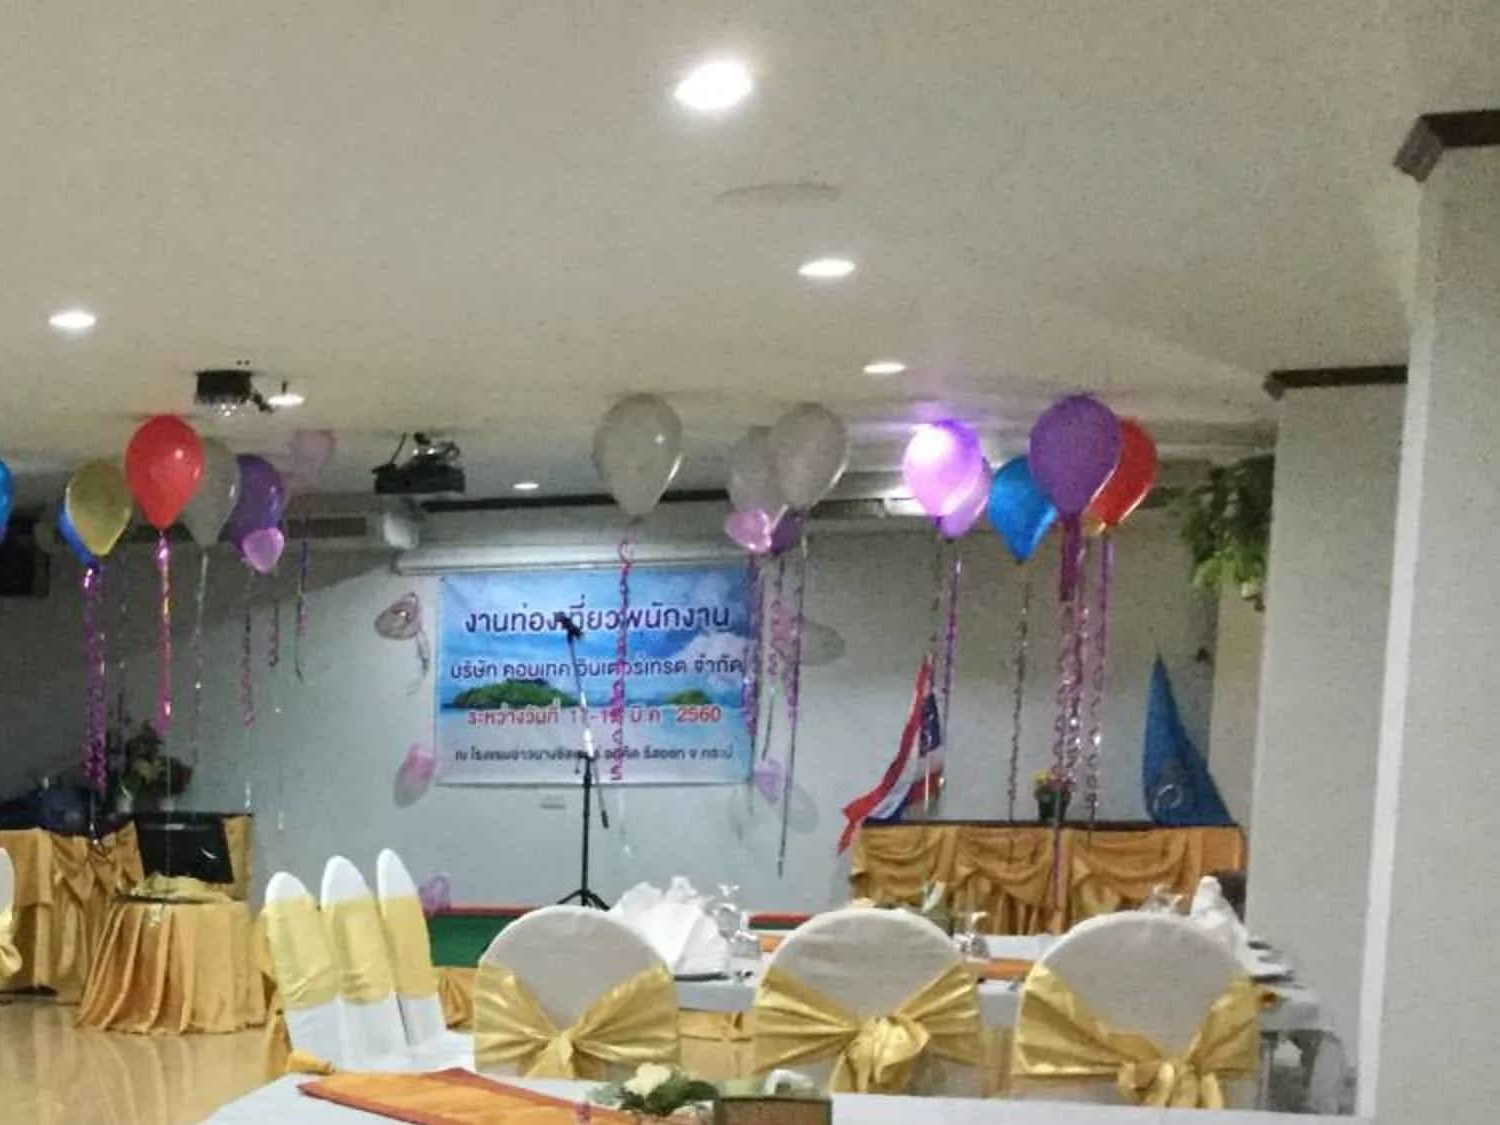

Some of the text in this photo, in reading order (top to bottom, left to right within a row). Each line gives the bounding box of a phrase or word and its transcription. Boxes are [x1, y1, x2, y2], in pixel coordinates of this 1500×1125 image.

[451, 658, 497, 679] บริษัท
[675, 704, 722, 724] 2560
